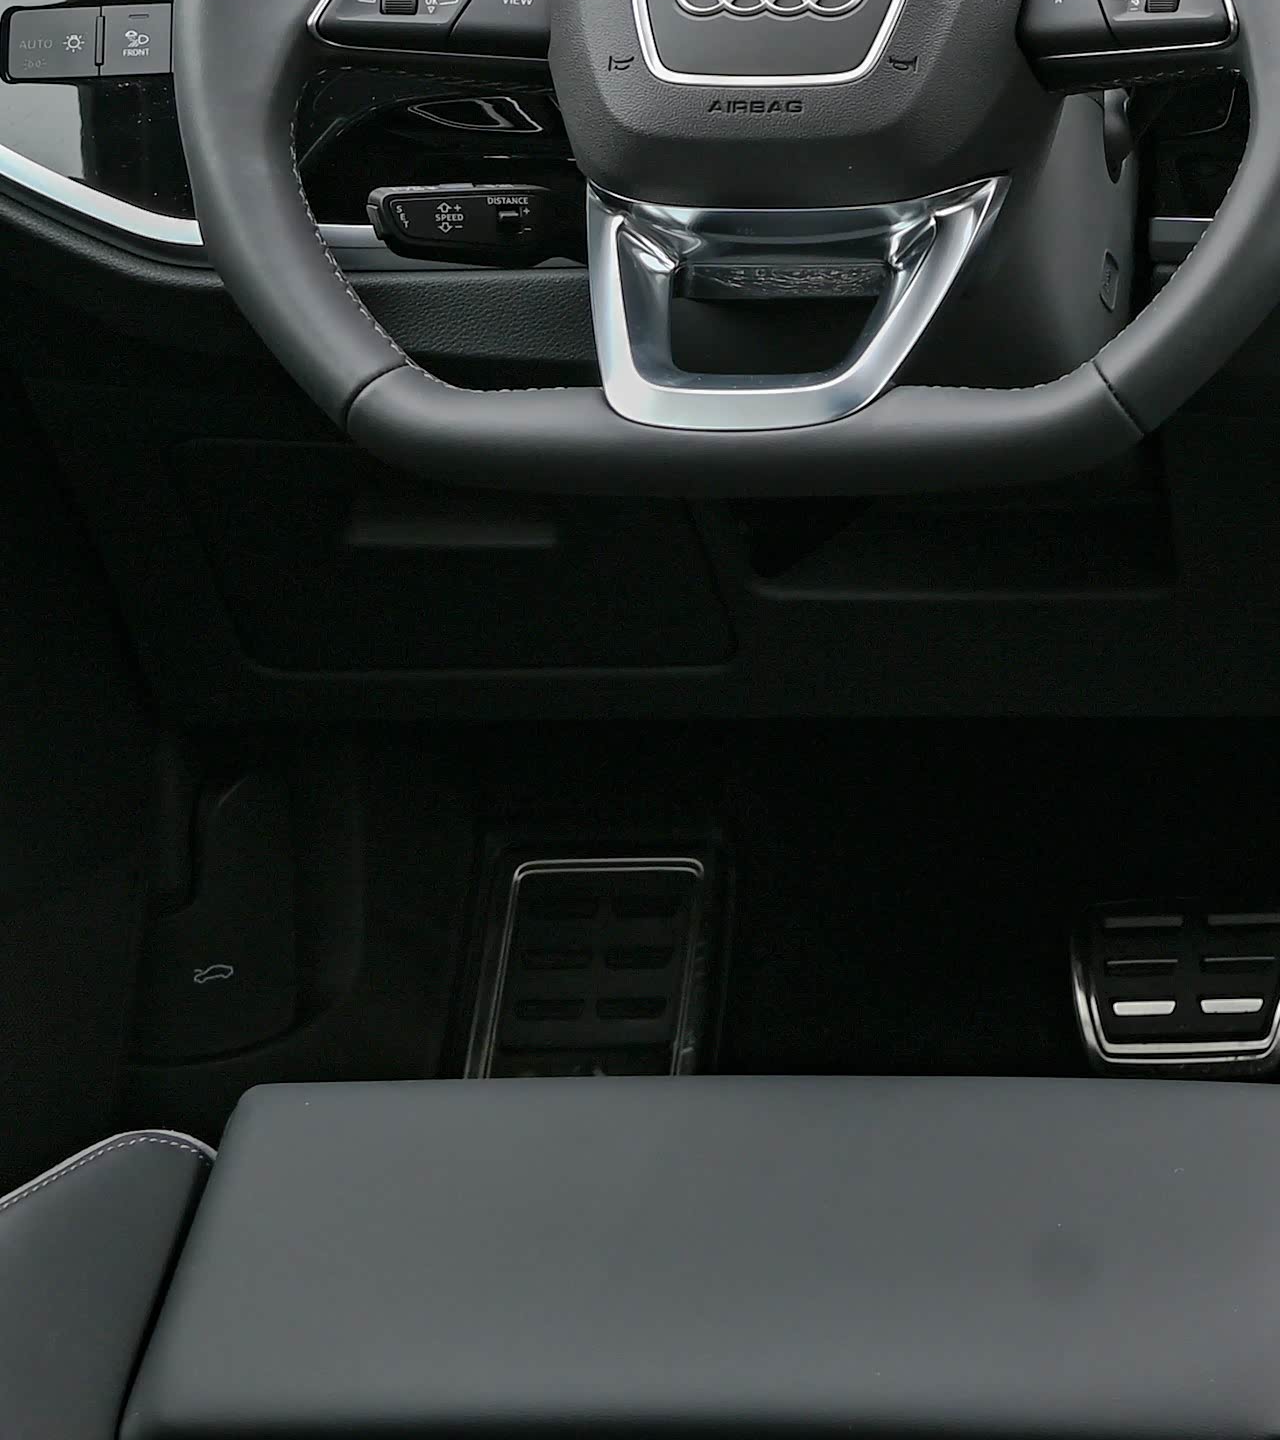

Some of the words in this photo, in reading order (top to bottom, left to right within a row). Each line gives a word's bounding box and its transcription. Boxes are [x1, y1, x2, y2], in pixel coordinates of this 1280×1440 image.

[18, 38, 53, 50] AUTO
[122, 47, 150, 57] FRONT
[707, 99, 805, 114] AIRBAG
[486, 196, 529, 206] DISTANCE
[435, 213, 464, 222] SPEED
